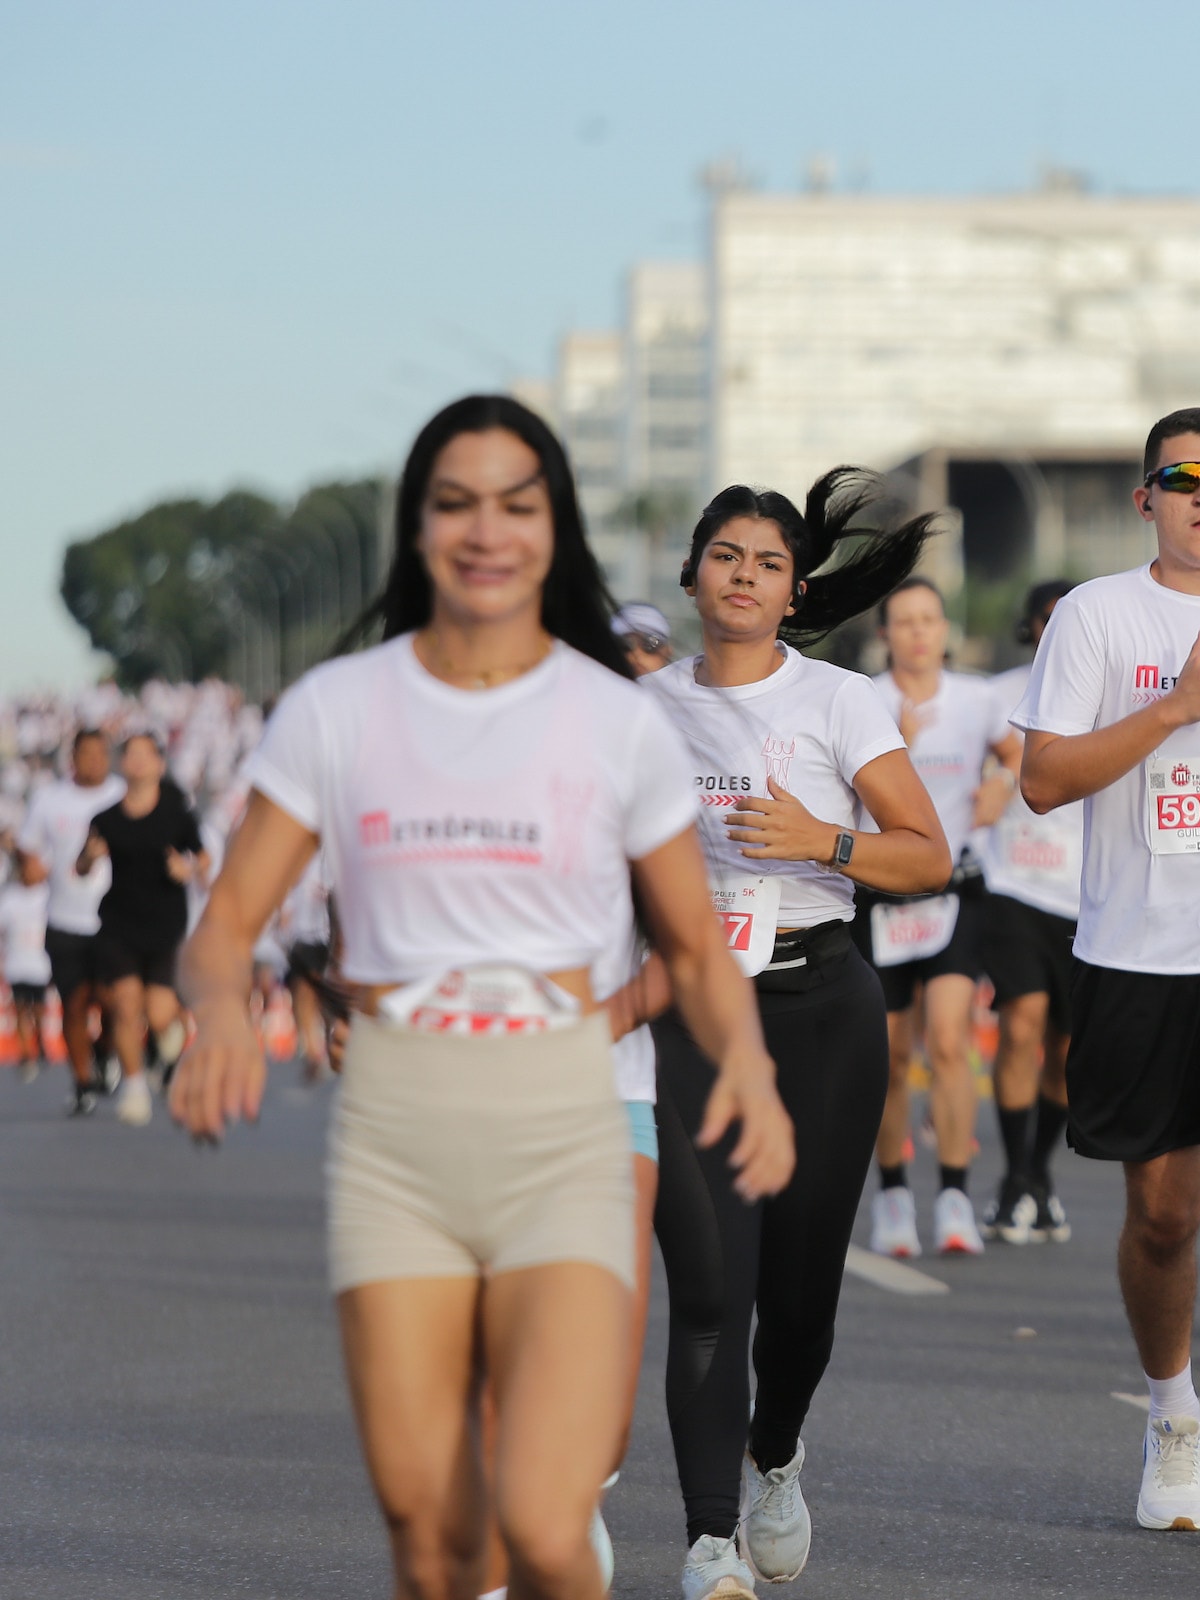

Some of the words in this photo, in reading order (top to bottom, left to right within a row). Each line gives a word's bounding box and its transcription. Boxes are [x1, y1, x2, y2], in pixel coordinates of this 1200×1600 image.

[694, 776, 751, 791] POLES
[714, 890, 736, 898] POLES
[742, 888, 755, 897] 5K
